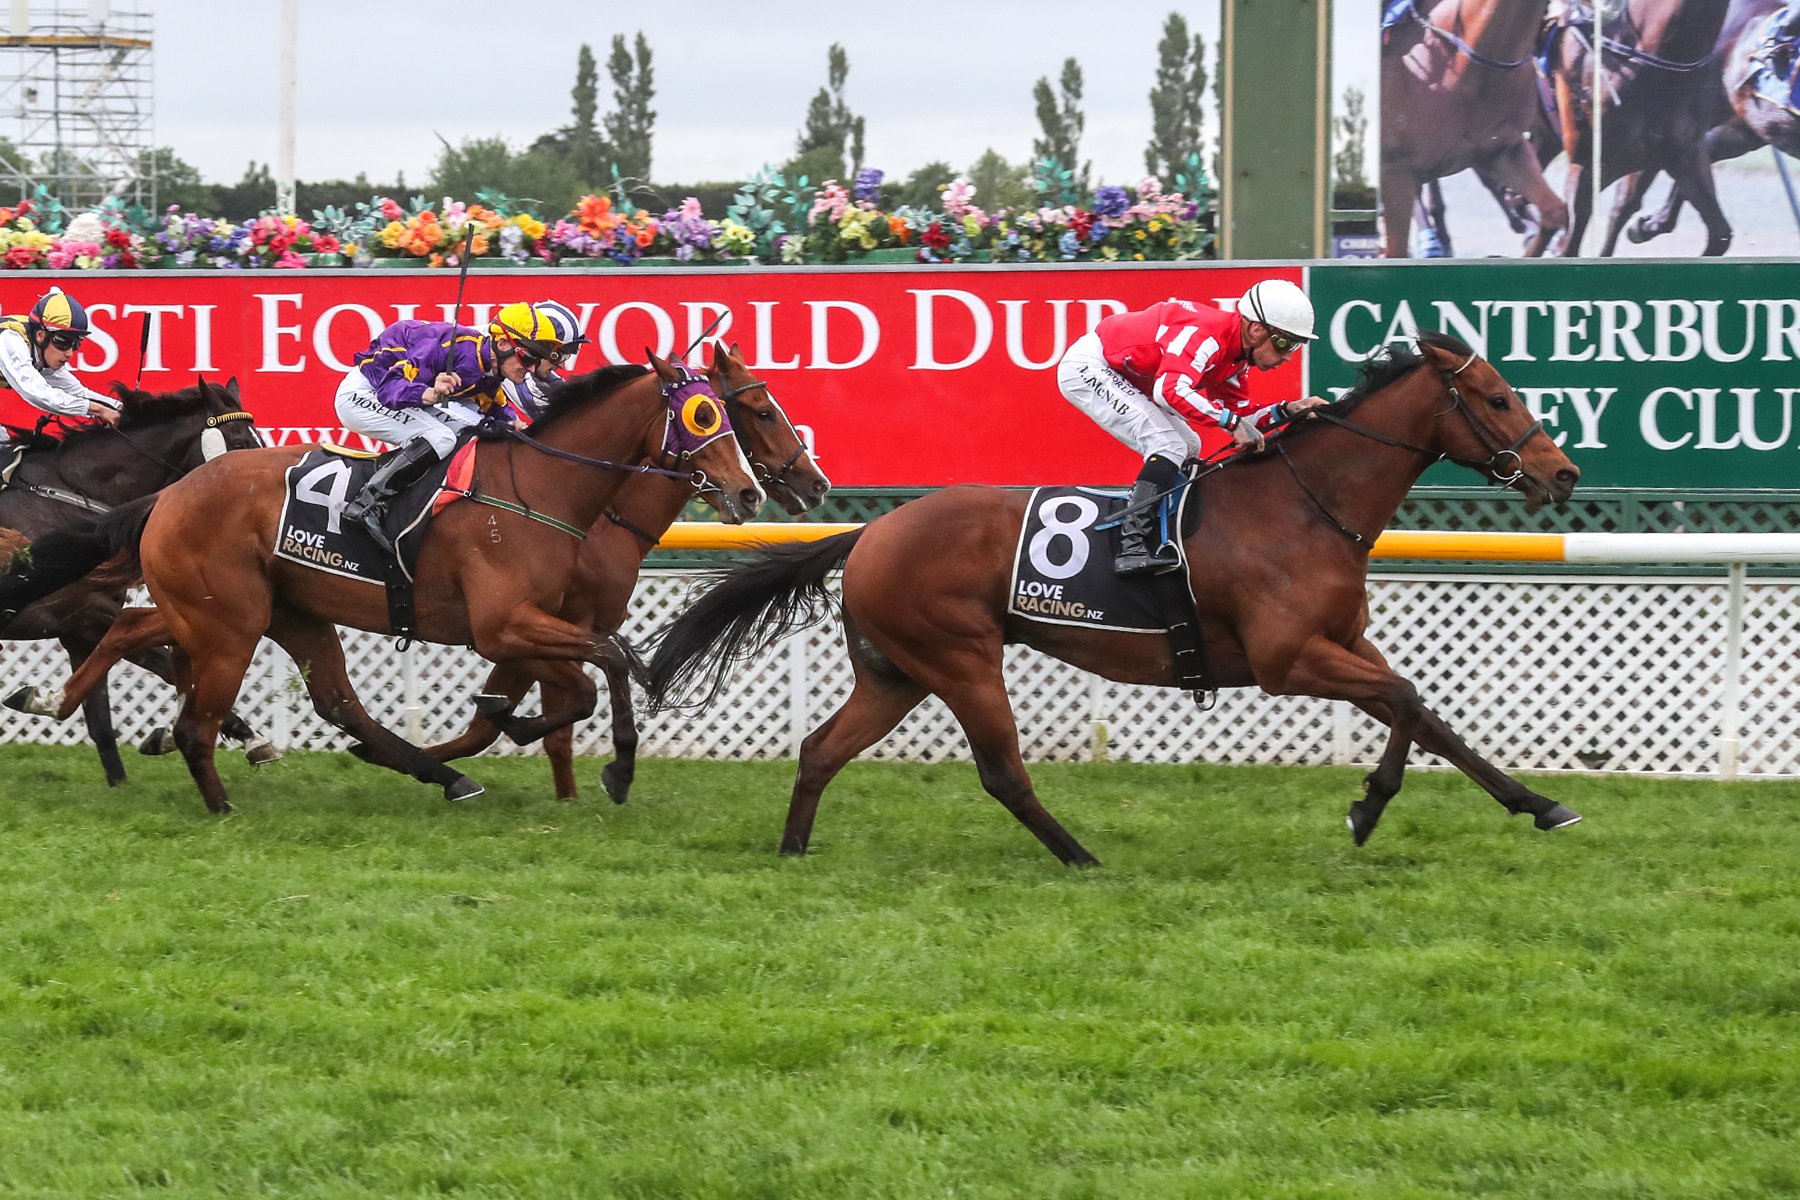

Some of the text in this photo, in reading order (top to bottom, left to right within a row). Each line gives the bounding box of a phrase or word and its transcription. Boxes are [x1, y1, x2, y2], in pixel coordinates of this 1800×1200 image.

[66, 303, 220, 373] STI
[347, 393, 415, 425] MOSELEY
[1640, 386, 1800, 450] CLU
[296, 460, 352, 534] 4
[287, 525, 325, 548] LOVE
[488, 515, 497, 526] 4
[491, 529, 501, 543] 5
[1029, 496, 1099, 579] 8
[283, 538, 360, 572] RACING.NZ
[1018, 580, 1064, 600] LOVE
[1016, 596, 1104, 620] RACING.NZ
